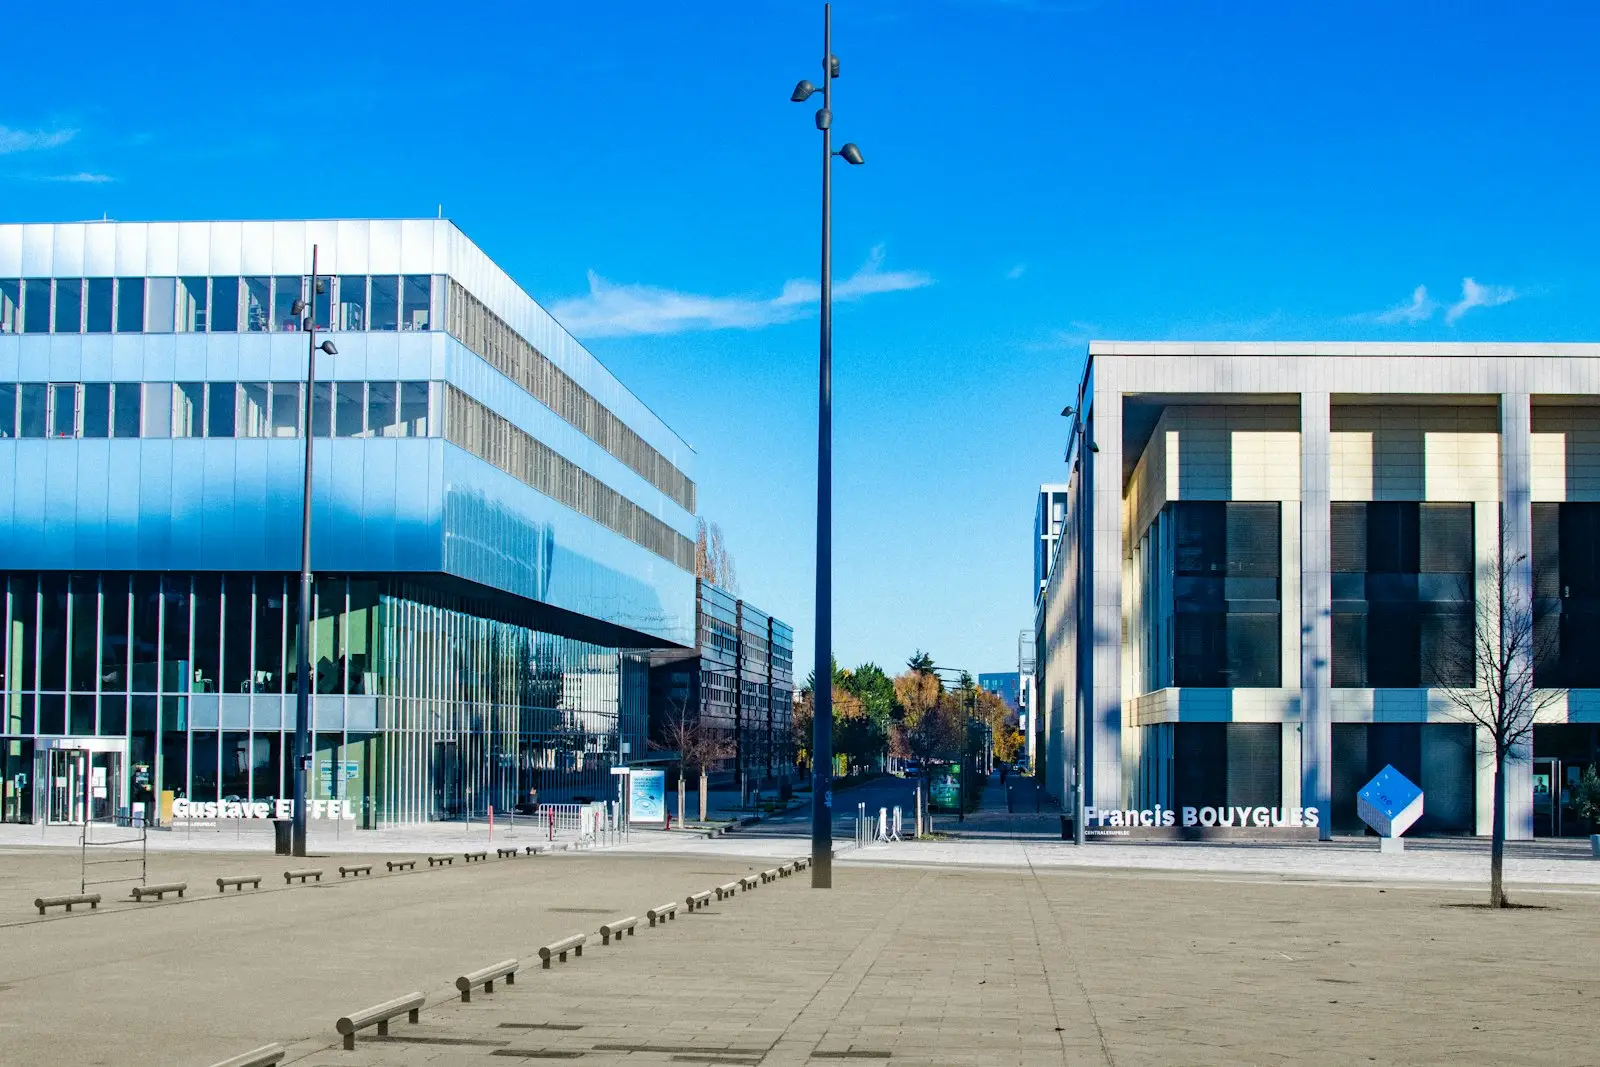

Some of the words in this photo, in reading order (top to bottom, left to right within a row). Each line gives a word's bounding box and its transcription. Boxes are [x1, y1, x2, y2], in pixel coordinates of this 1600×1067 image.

[172, 798, 270, 820] Gustave
[1084, 804, 1175, 827] Francis
[1182, 806, 1320, 828] BOUYGUES
